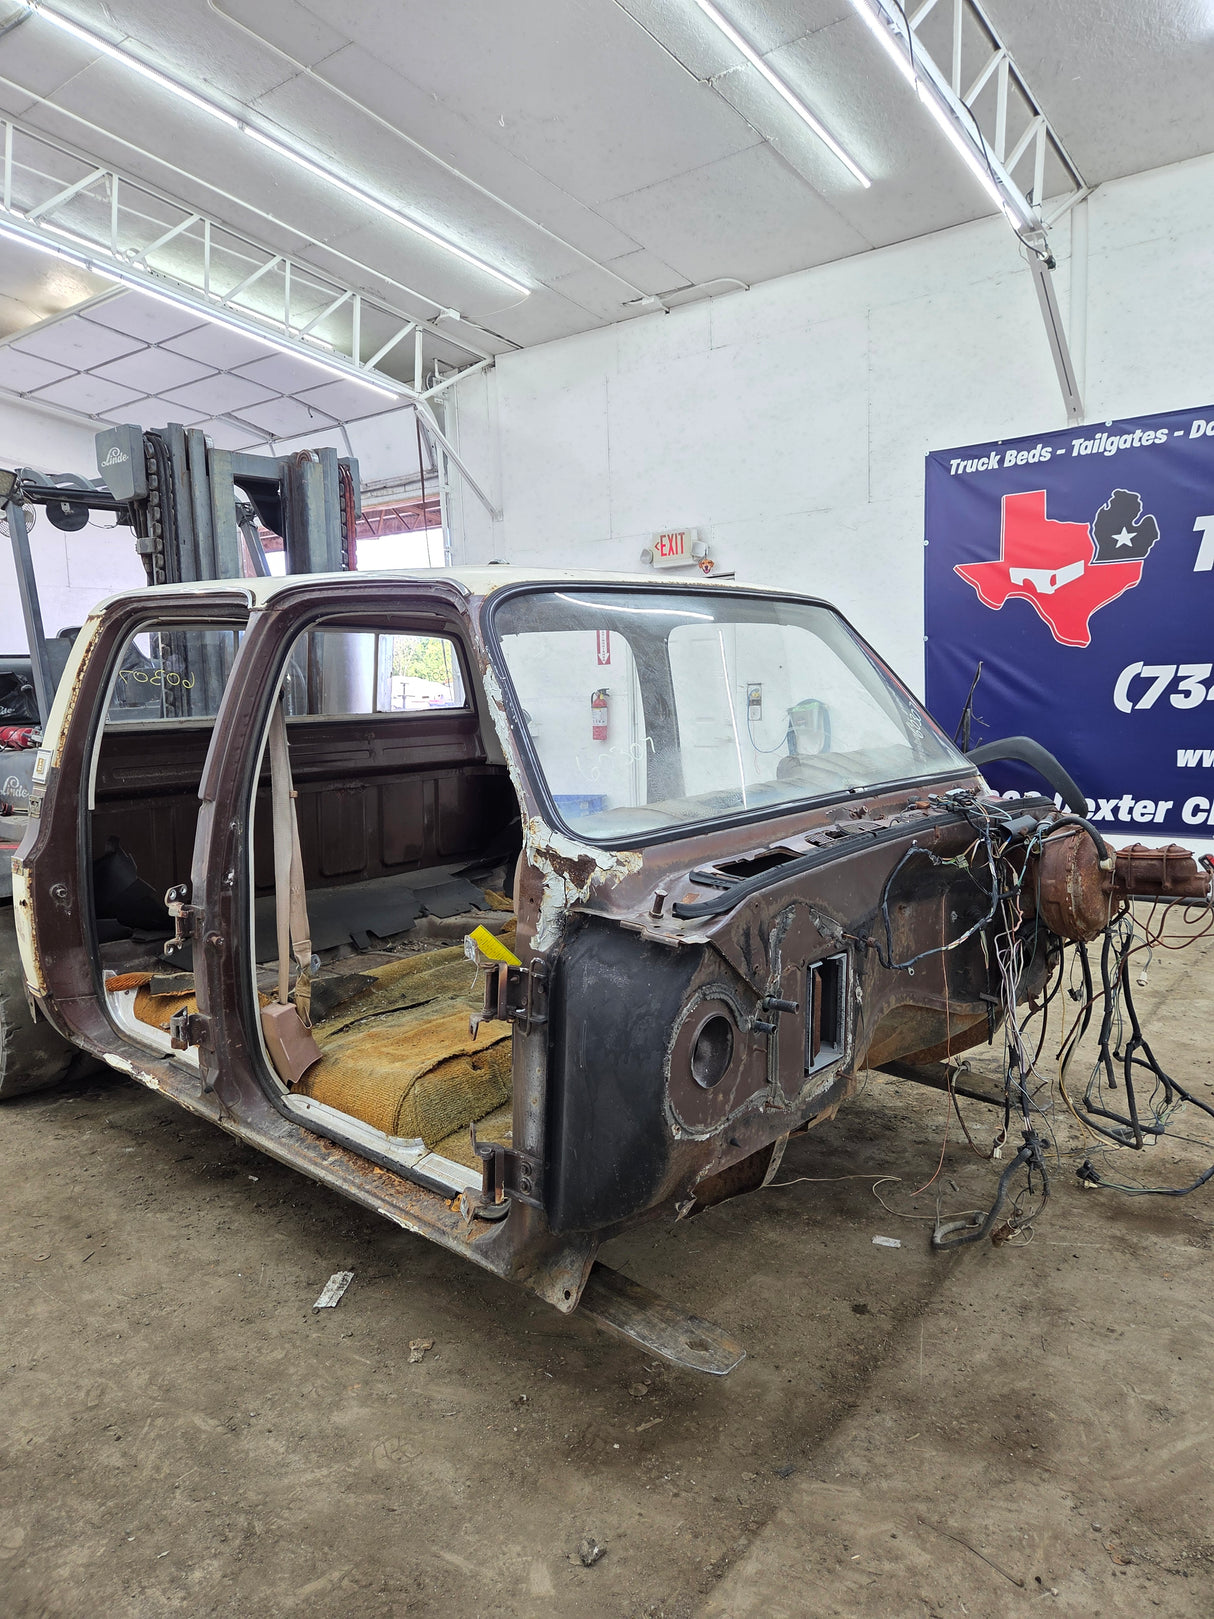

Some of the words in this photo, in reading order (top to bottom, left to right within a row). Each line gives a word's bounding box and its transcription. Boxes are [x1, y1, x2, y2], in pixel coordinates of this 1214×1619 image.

[101, 446, 129, 468] Linde
[950, 451, 1000, 476] Truck
[1003, 444, 1052, 468] Beds
[1071, 428, 1168, 457] Tailgates
[660, 532, 685, 557] EXIT
[1113, 661, 1214, 714] (73
[0, 775, 30, 798] Linde
